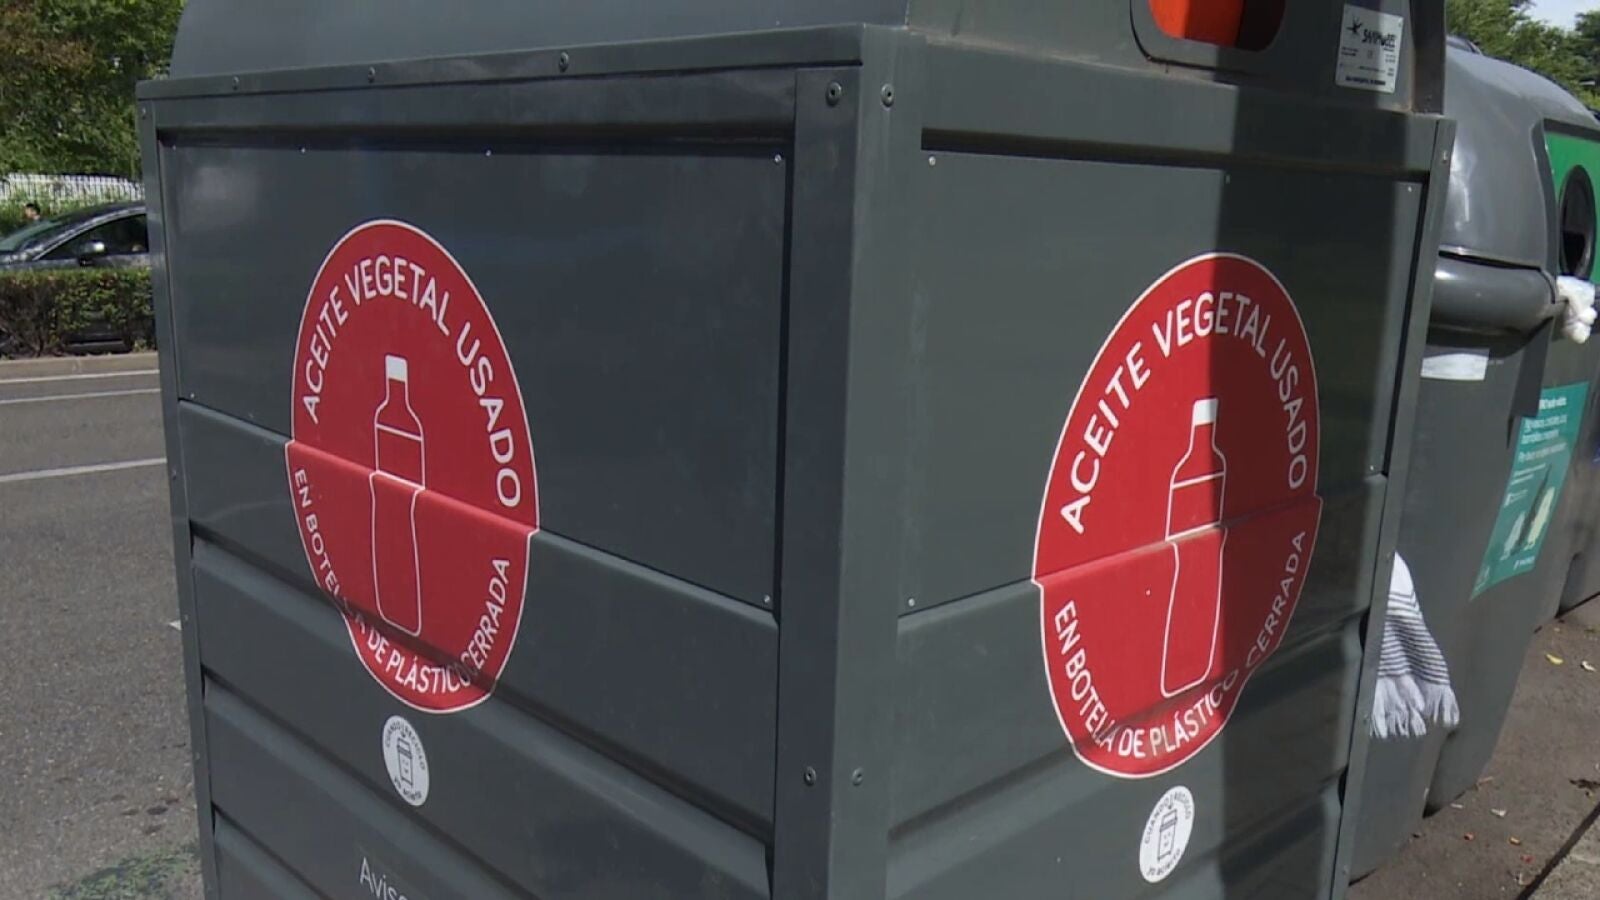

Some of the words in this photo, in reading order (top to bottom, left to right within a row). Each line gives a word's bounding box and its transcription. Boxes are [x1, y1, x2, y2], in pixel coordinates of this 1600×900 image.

[303, 286, 348, 424] ACEITE
[345, 255, 450, 336] VEGETAL
[456, 321, 521, 508] USADO
[1060, 342, 1150, 534] ACEITE
[1152, 291, 1271, 358] VEGETAL
[1270, 338, 1307, 489] USADO
[294, 469, 312, 508] EN
[367, 629, 390, 665] DE
[461, 558, 511, 676] CERRADA
[1054, 600, 1081, 654] EN
[1118, 728, 1146, 758] DE
[1150, 669, 1239, 756] PLÁSTICO
[1245, 531, 1306, 668] CERRADA
[360, 856, 408, 900] Avis
